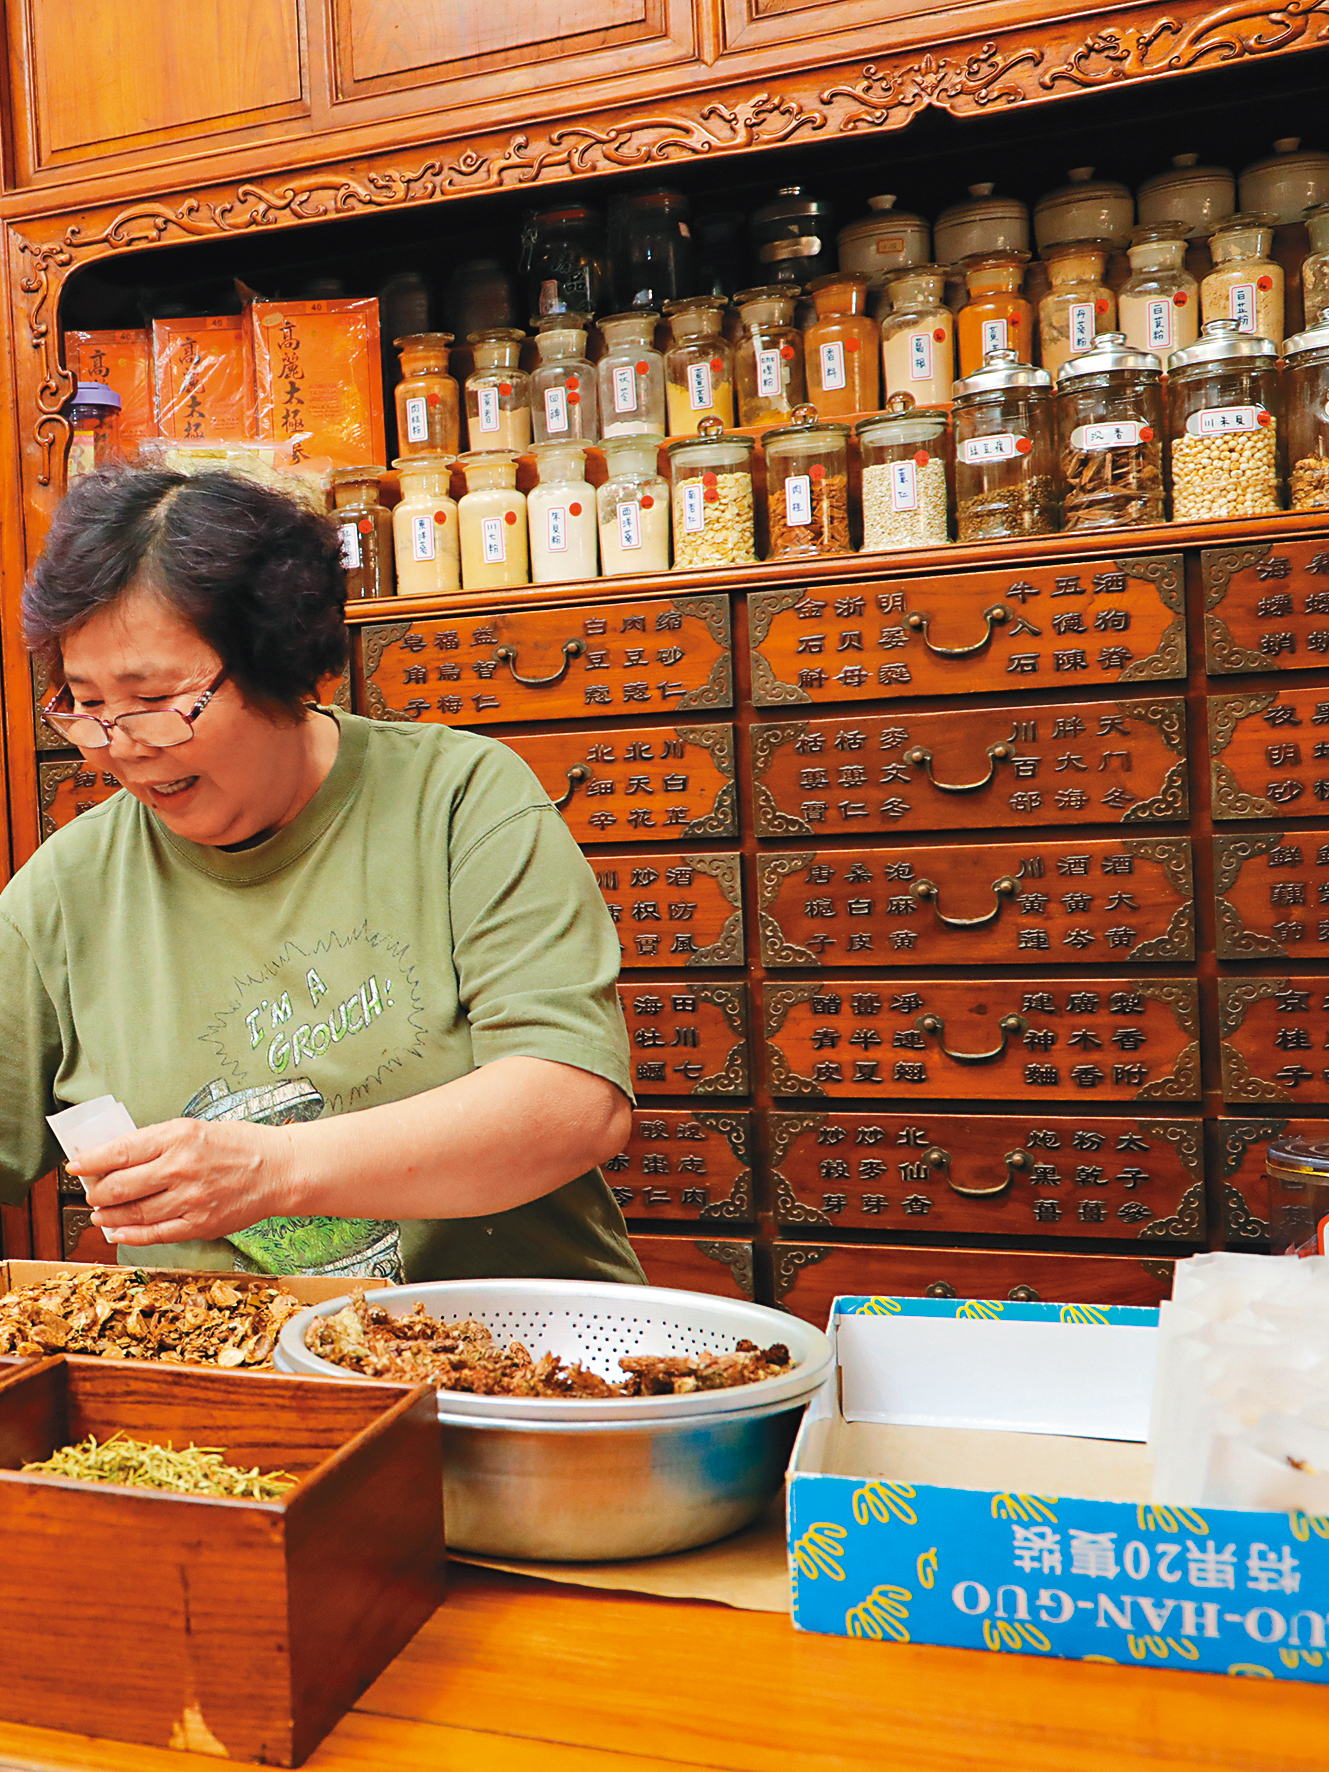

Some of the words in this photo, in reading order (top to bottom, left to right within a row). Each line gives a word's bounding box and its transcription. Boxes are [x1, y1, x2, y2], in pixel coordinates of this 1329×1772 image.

[826, 348, 837, 377] 香料
[471, 627, 499, 711] 益智仁
[267, 975, 395, 1074] GROUCH!
[306, 968, 328, 1008] A
[671, 995, 703, 1079] 田川七
[952, 1581, 1329, 1648] UO-HAN-GUO
